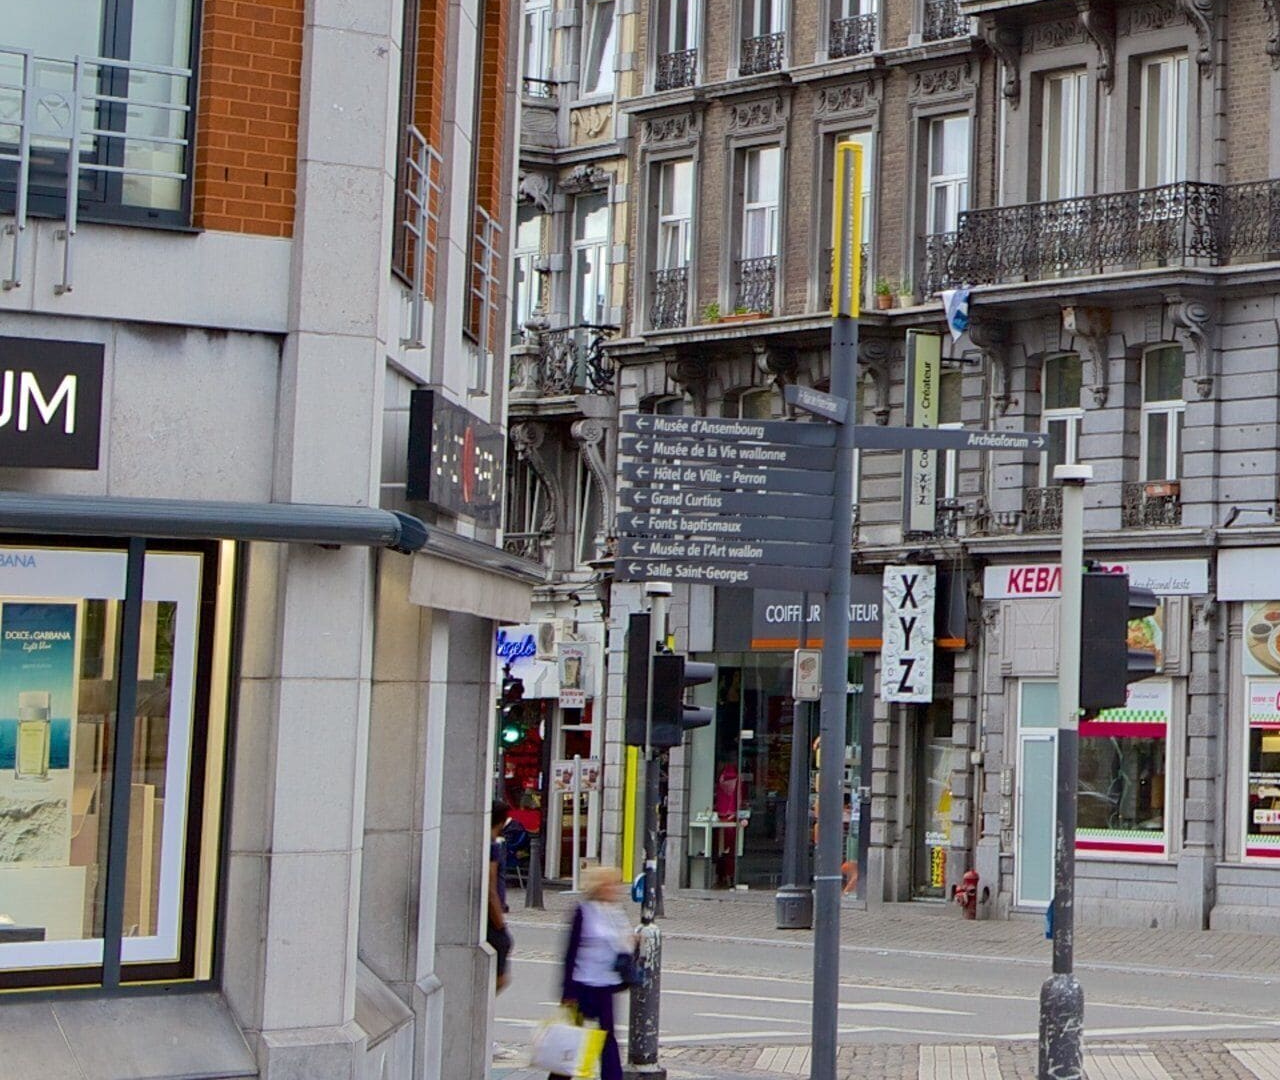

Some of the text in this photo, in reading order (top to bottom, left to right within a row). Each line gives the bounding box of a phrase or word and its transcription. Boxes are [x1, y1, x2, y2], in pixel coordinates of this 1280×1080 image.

[921, 362, 932, 409] Créateur
[653, 418, 765, 438] Musée d'Ansembourg
[968, 433, 1028, 448] Archéoforum
[653, 442, 786, 461] Musée de la Vie wallonne
[653, 466, 681, 481] Hôtel
[683, 468, 697, 482] de
[700, 468, 722, 483] Ville
[733, 471, 766, 485] Perron
[651, 492, 722, 507] Grand Curtius
[648, 517, 741, 534] Fonts baptismaux
[650, 542, 763, 558] Musée de l'Art wallon
[646, 563, 749, 583] Salle Saint-Georges
[898, 574, 918, 694] XYZ
